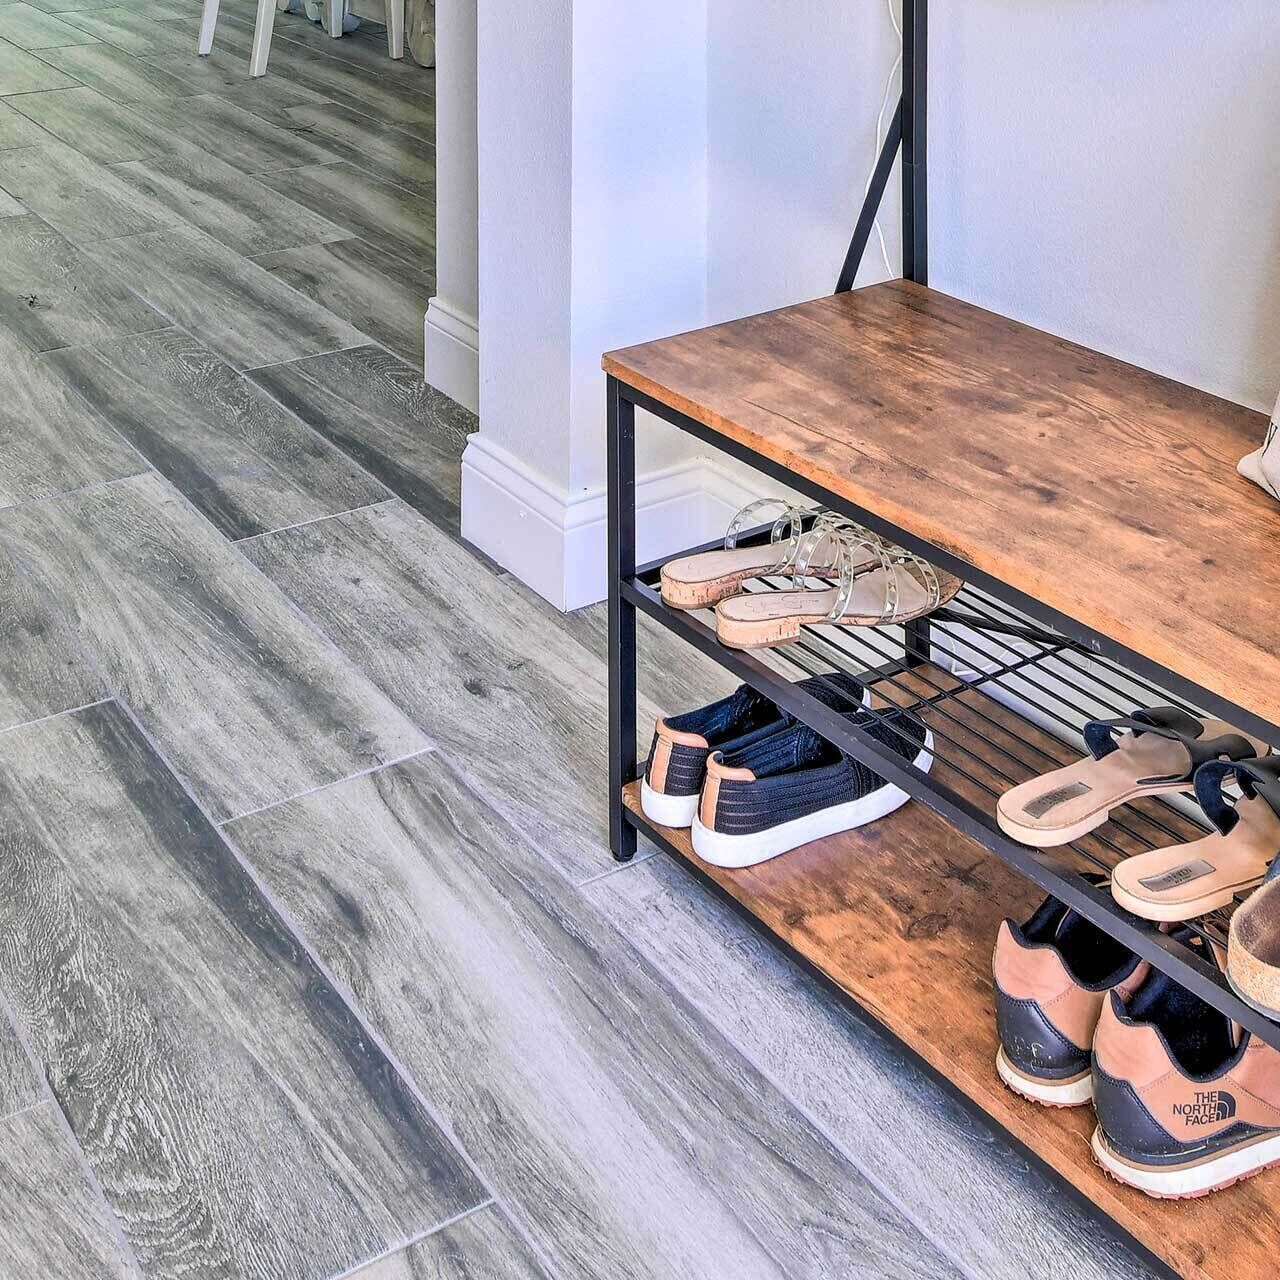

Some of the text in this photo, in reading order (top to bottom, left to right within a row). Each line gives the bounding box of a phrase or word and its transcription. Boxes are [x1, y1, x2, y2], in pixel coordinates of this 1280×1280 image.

[1194, 1090, 1218, 1104] THE
[1172, 1102, 1218, 1116] NORTH
[1184, 1113, 1217, 1126] FACE
